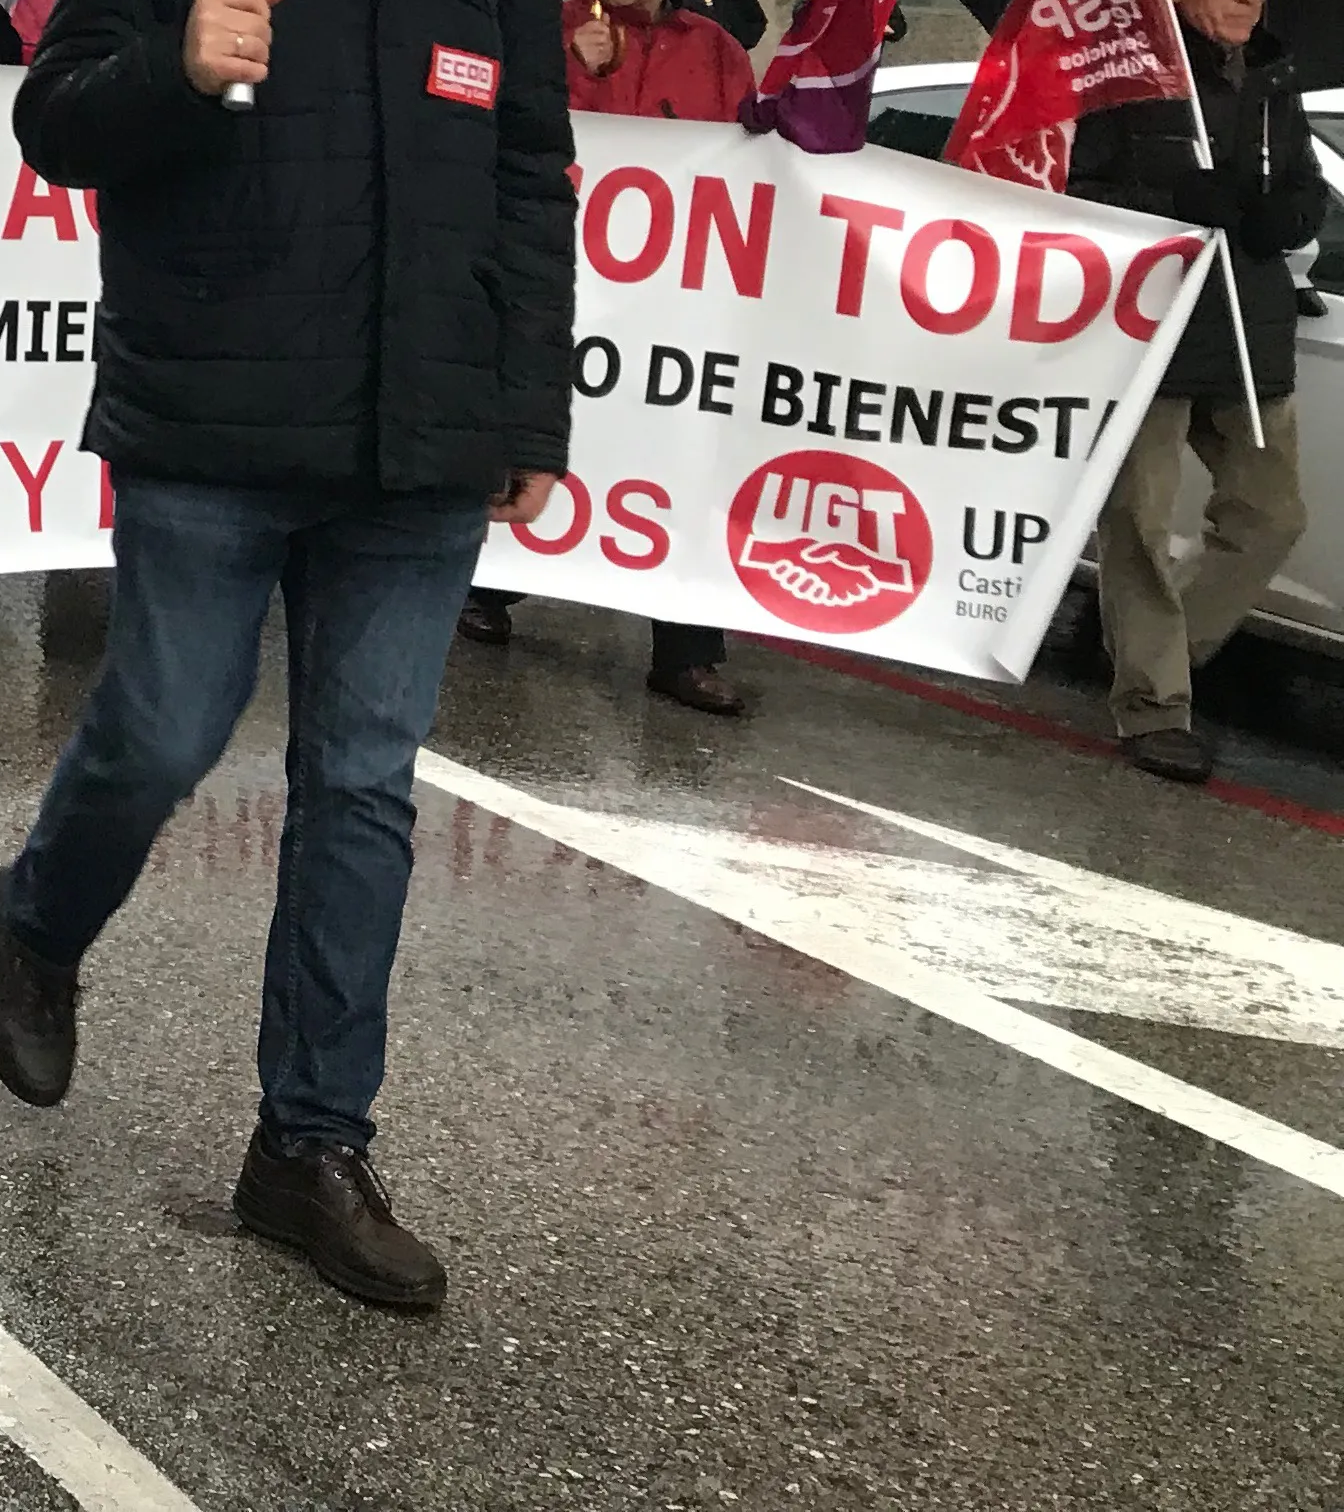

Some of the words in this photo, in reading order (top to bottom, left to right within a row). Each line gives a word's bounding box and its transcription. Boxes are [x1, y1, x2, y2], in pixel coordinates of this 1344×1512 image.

[440, 57, 490, 84] CCOO
[564, 162, 777, 299] ON
[645, 344, 740, 416] DE
[0, 440, 64, 533] Y
[753, 472, 909, 559] UGT
